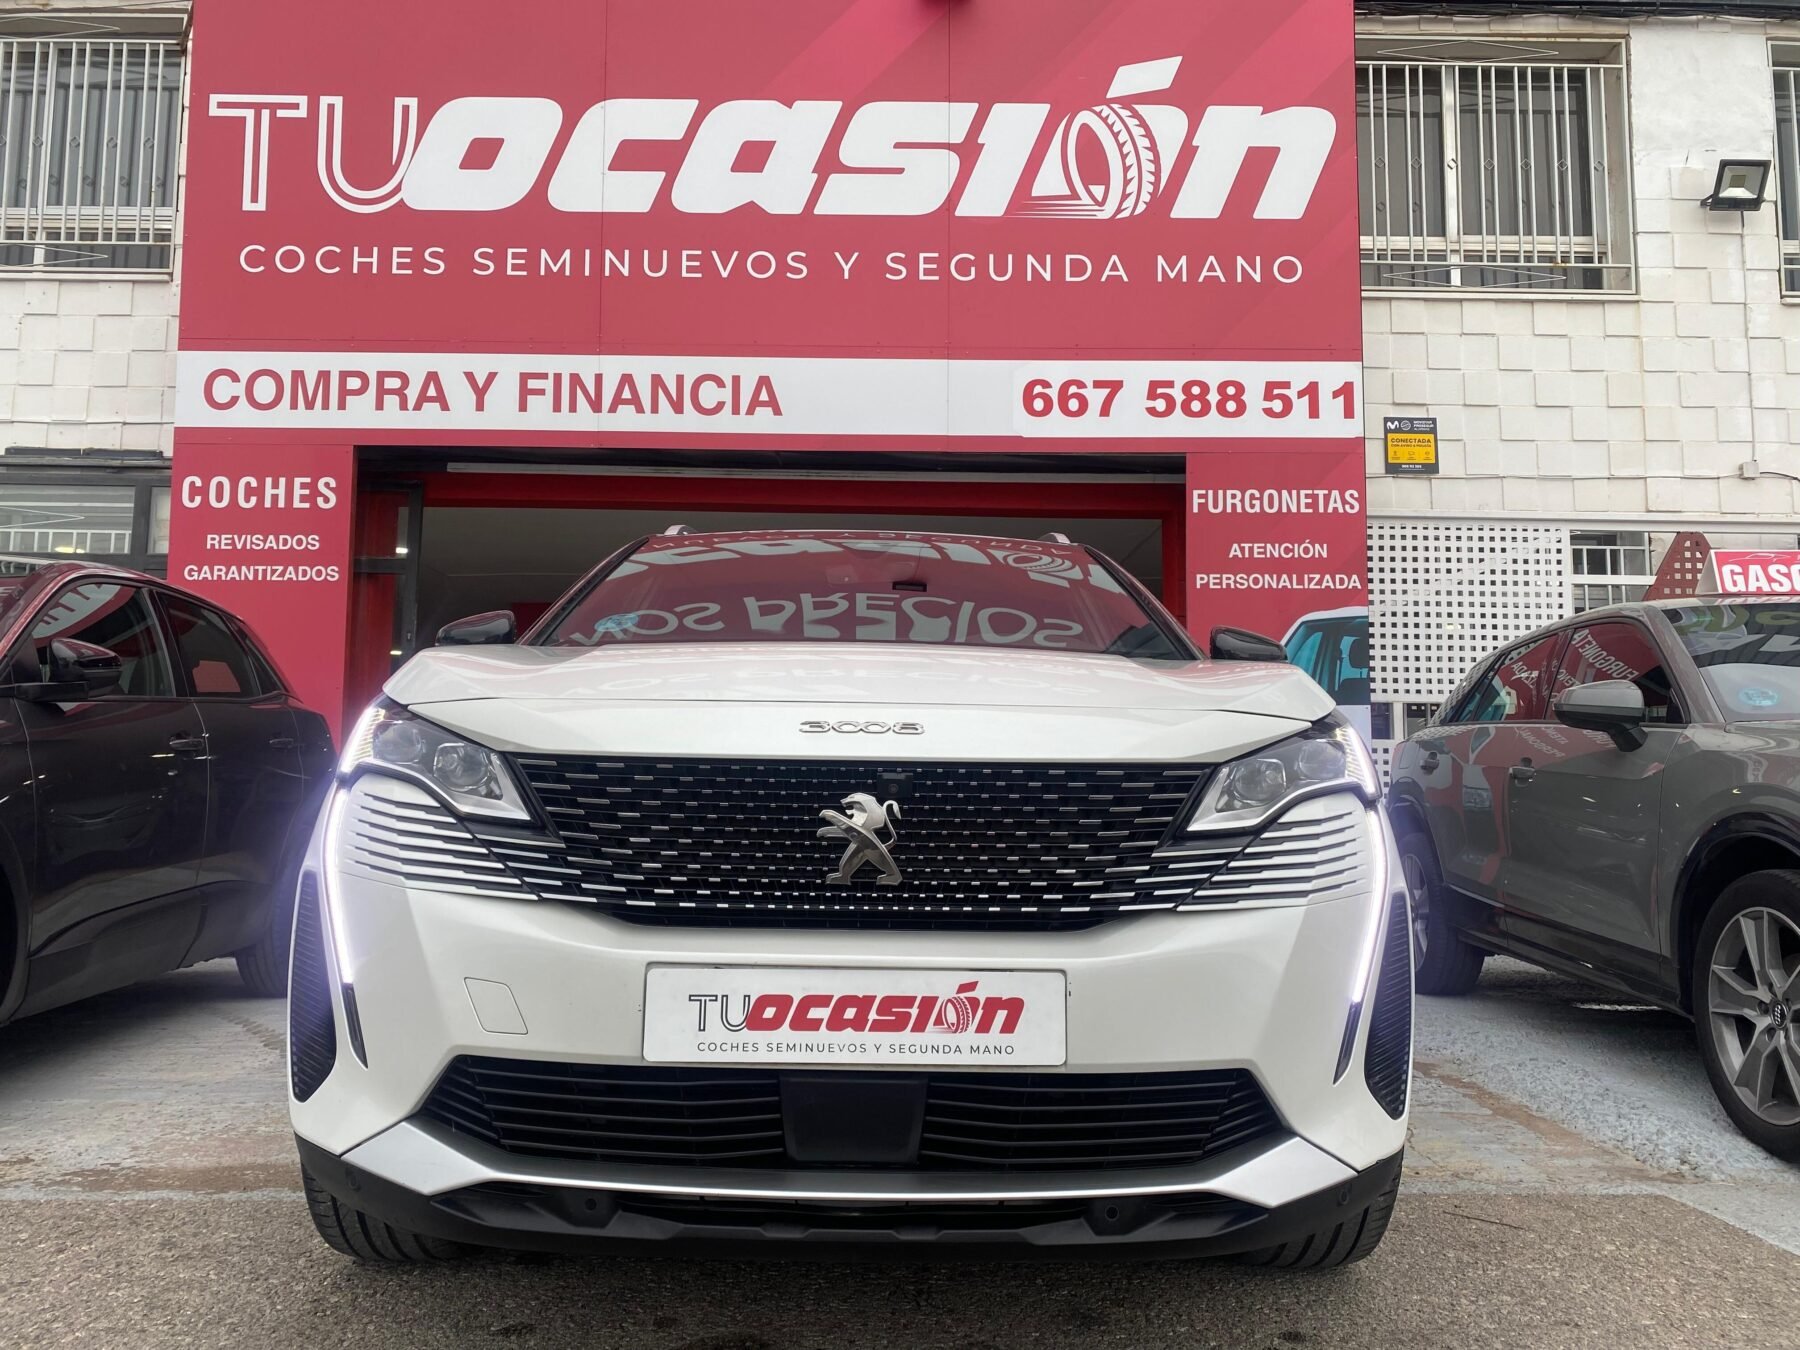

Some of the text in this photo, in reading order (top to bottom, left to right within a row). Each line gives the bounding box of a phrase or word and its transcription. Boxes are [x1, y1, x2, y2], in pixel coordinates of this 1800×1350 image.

[239, 244, 1304, 285] COCHES SEMINUEVOS Y SEGUNDA MANO
[203, 367, 782, 417] COMPRA Y FINANCIA
[1021, 378, 1356, 420] 667 588 511
[181, 475, 337, 510] COCHES
[1192, 488, 1361, 515] FURGONETAS
[206, 534, 321, 551] REVISADOS
[1228, 541, 1329, 560] ATENCIÓN
[183, 564, 340, 583] GARANTIZADOS
[1196, 573, 1363, 591] PERSONALIZADA
[799, 720, 925, 735] 3008
[697, 1042, 1015, 1055] COCHES SEMINUEVOS Y SEGUNDA MANO
